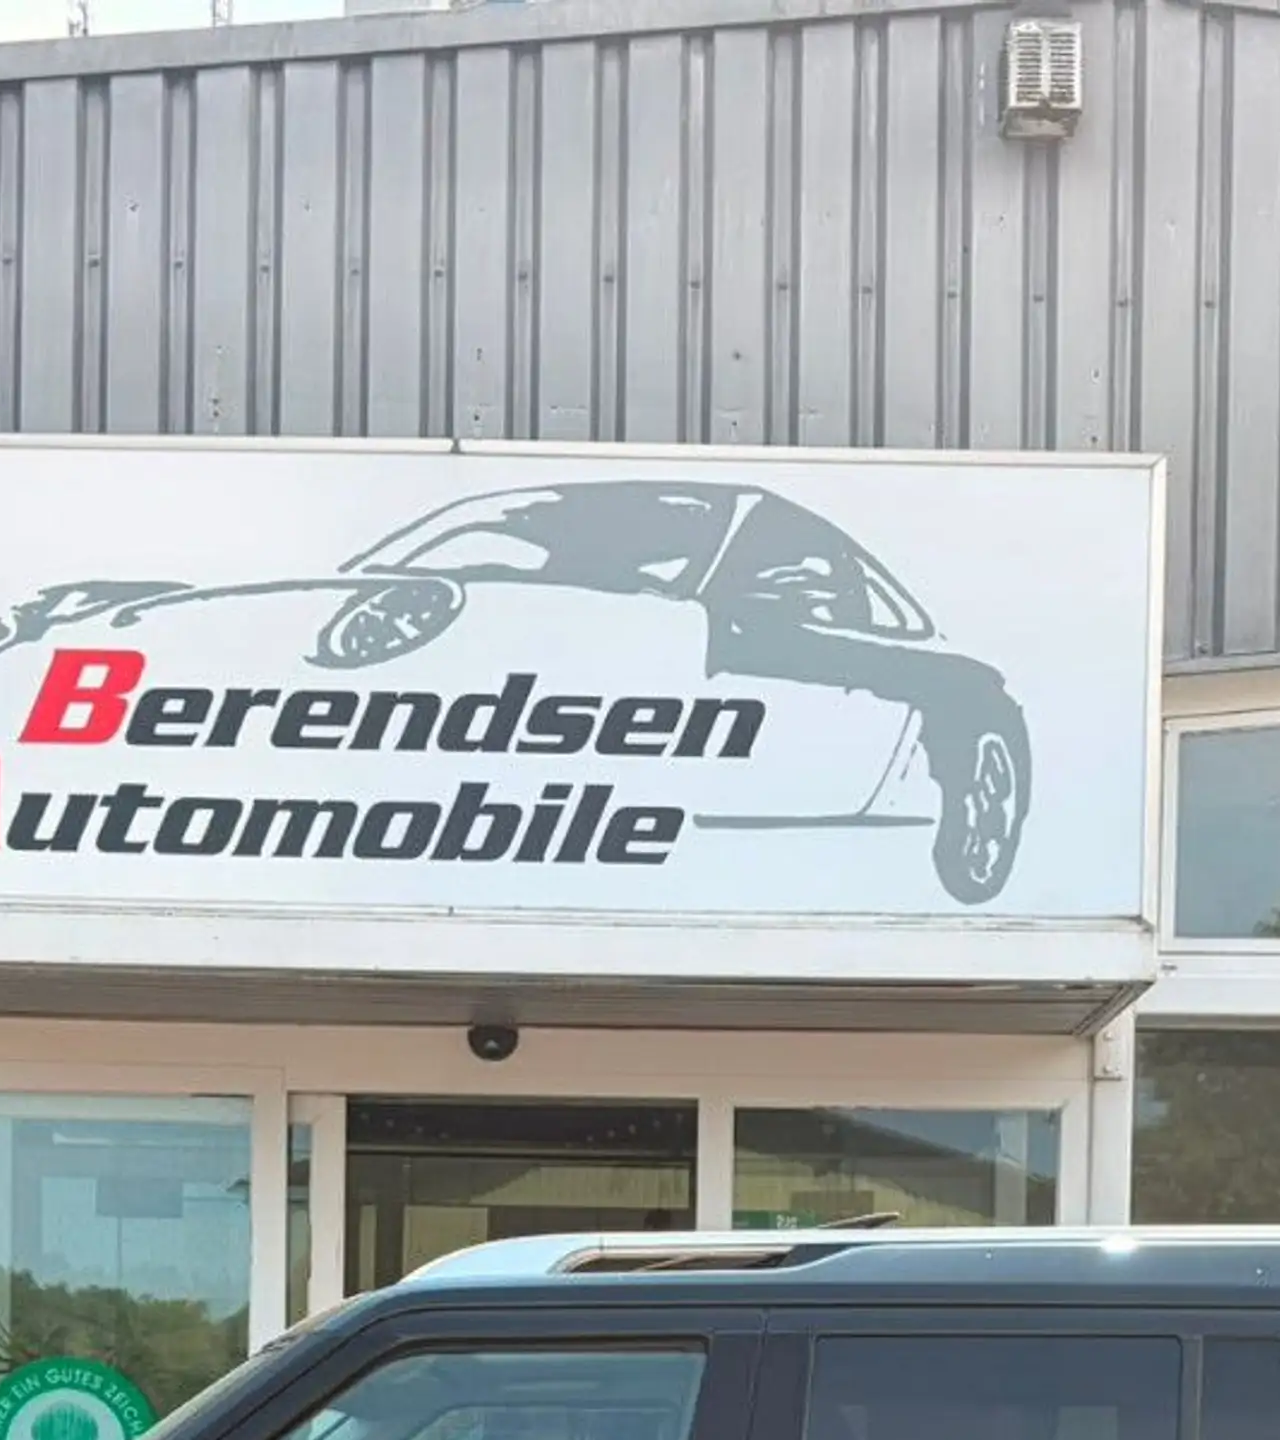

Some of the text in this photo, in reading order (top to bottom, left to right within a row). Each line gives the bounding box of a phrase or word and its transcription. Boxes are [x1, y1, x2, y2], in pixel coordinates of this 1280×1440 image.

[18, 648, 766, 758] Berendsen
[12, 1373, 41, 1400] EIN
[45, 1368, 104, 1389] GUTES
[104, 1382, 144, 1434] ZEICH
